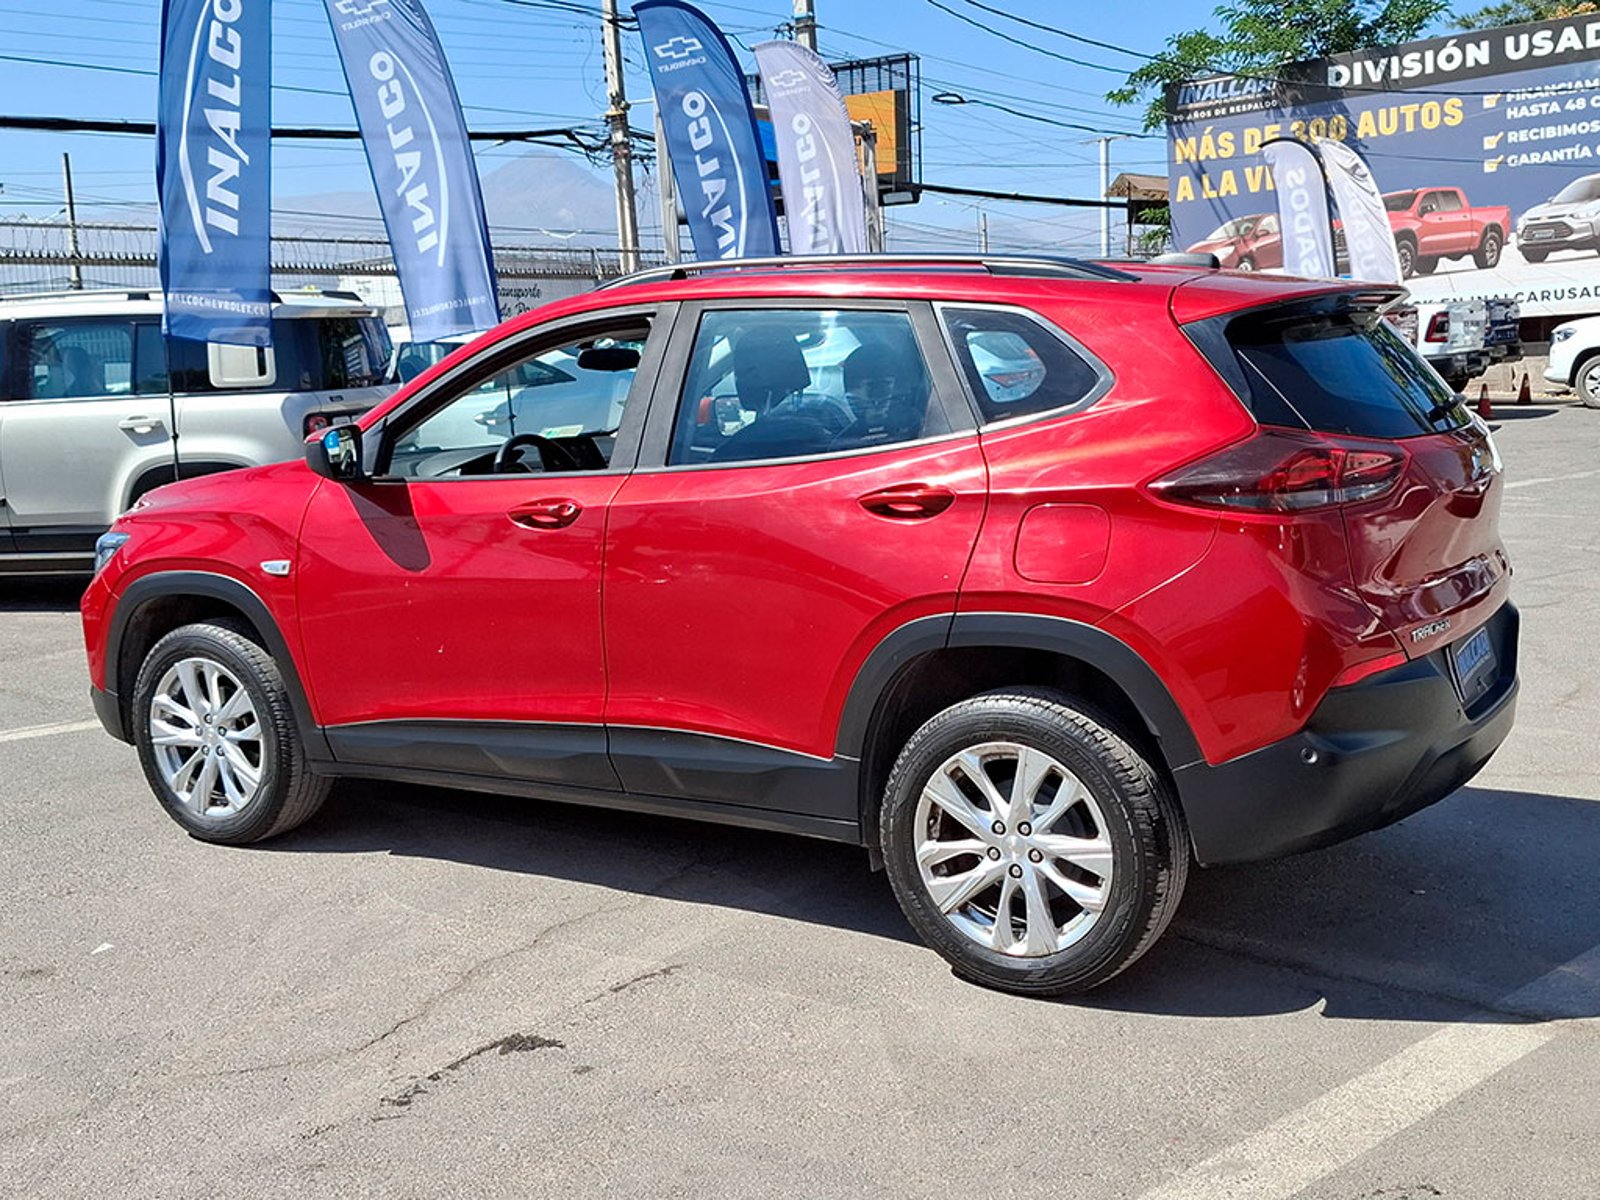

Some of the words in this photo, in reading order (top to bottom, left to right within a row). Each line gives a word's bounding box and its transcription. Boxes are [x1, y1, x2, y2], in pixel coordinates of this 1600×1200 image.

[1327, 38, 1490, 88] DIVISIÓN
[1187, 109, 1212, 121] AÑOS
[1214, 106, 1227, 116] DE
[1506, 101, 1561, 120] HASTA
[1564, 97, 1587, 112] 48
[1174, 126, 1236, 164] MÁS
[1357, 97, 1464, 139] AUTOS
[1507, 120, 1600, 144] RECIBIMOS
[1506, 143, 1593, 167] GARANTÍA
[1176, 176, 1194, 203] A
[1202, 169, 1239, 199] LA
